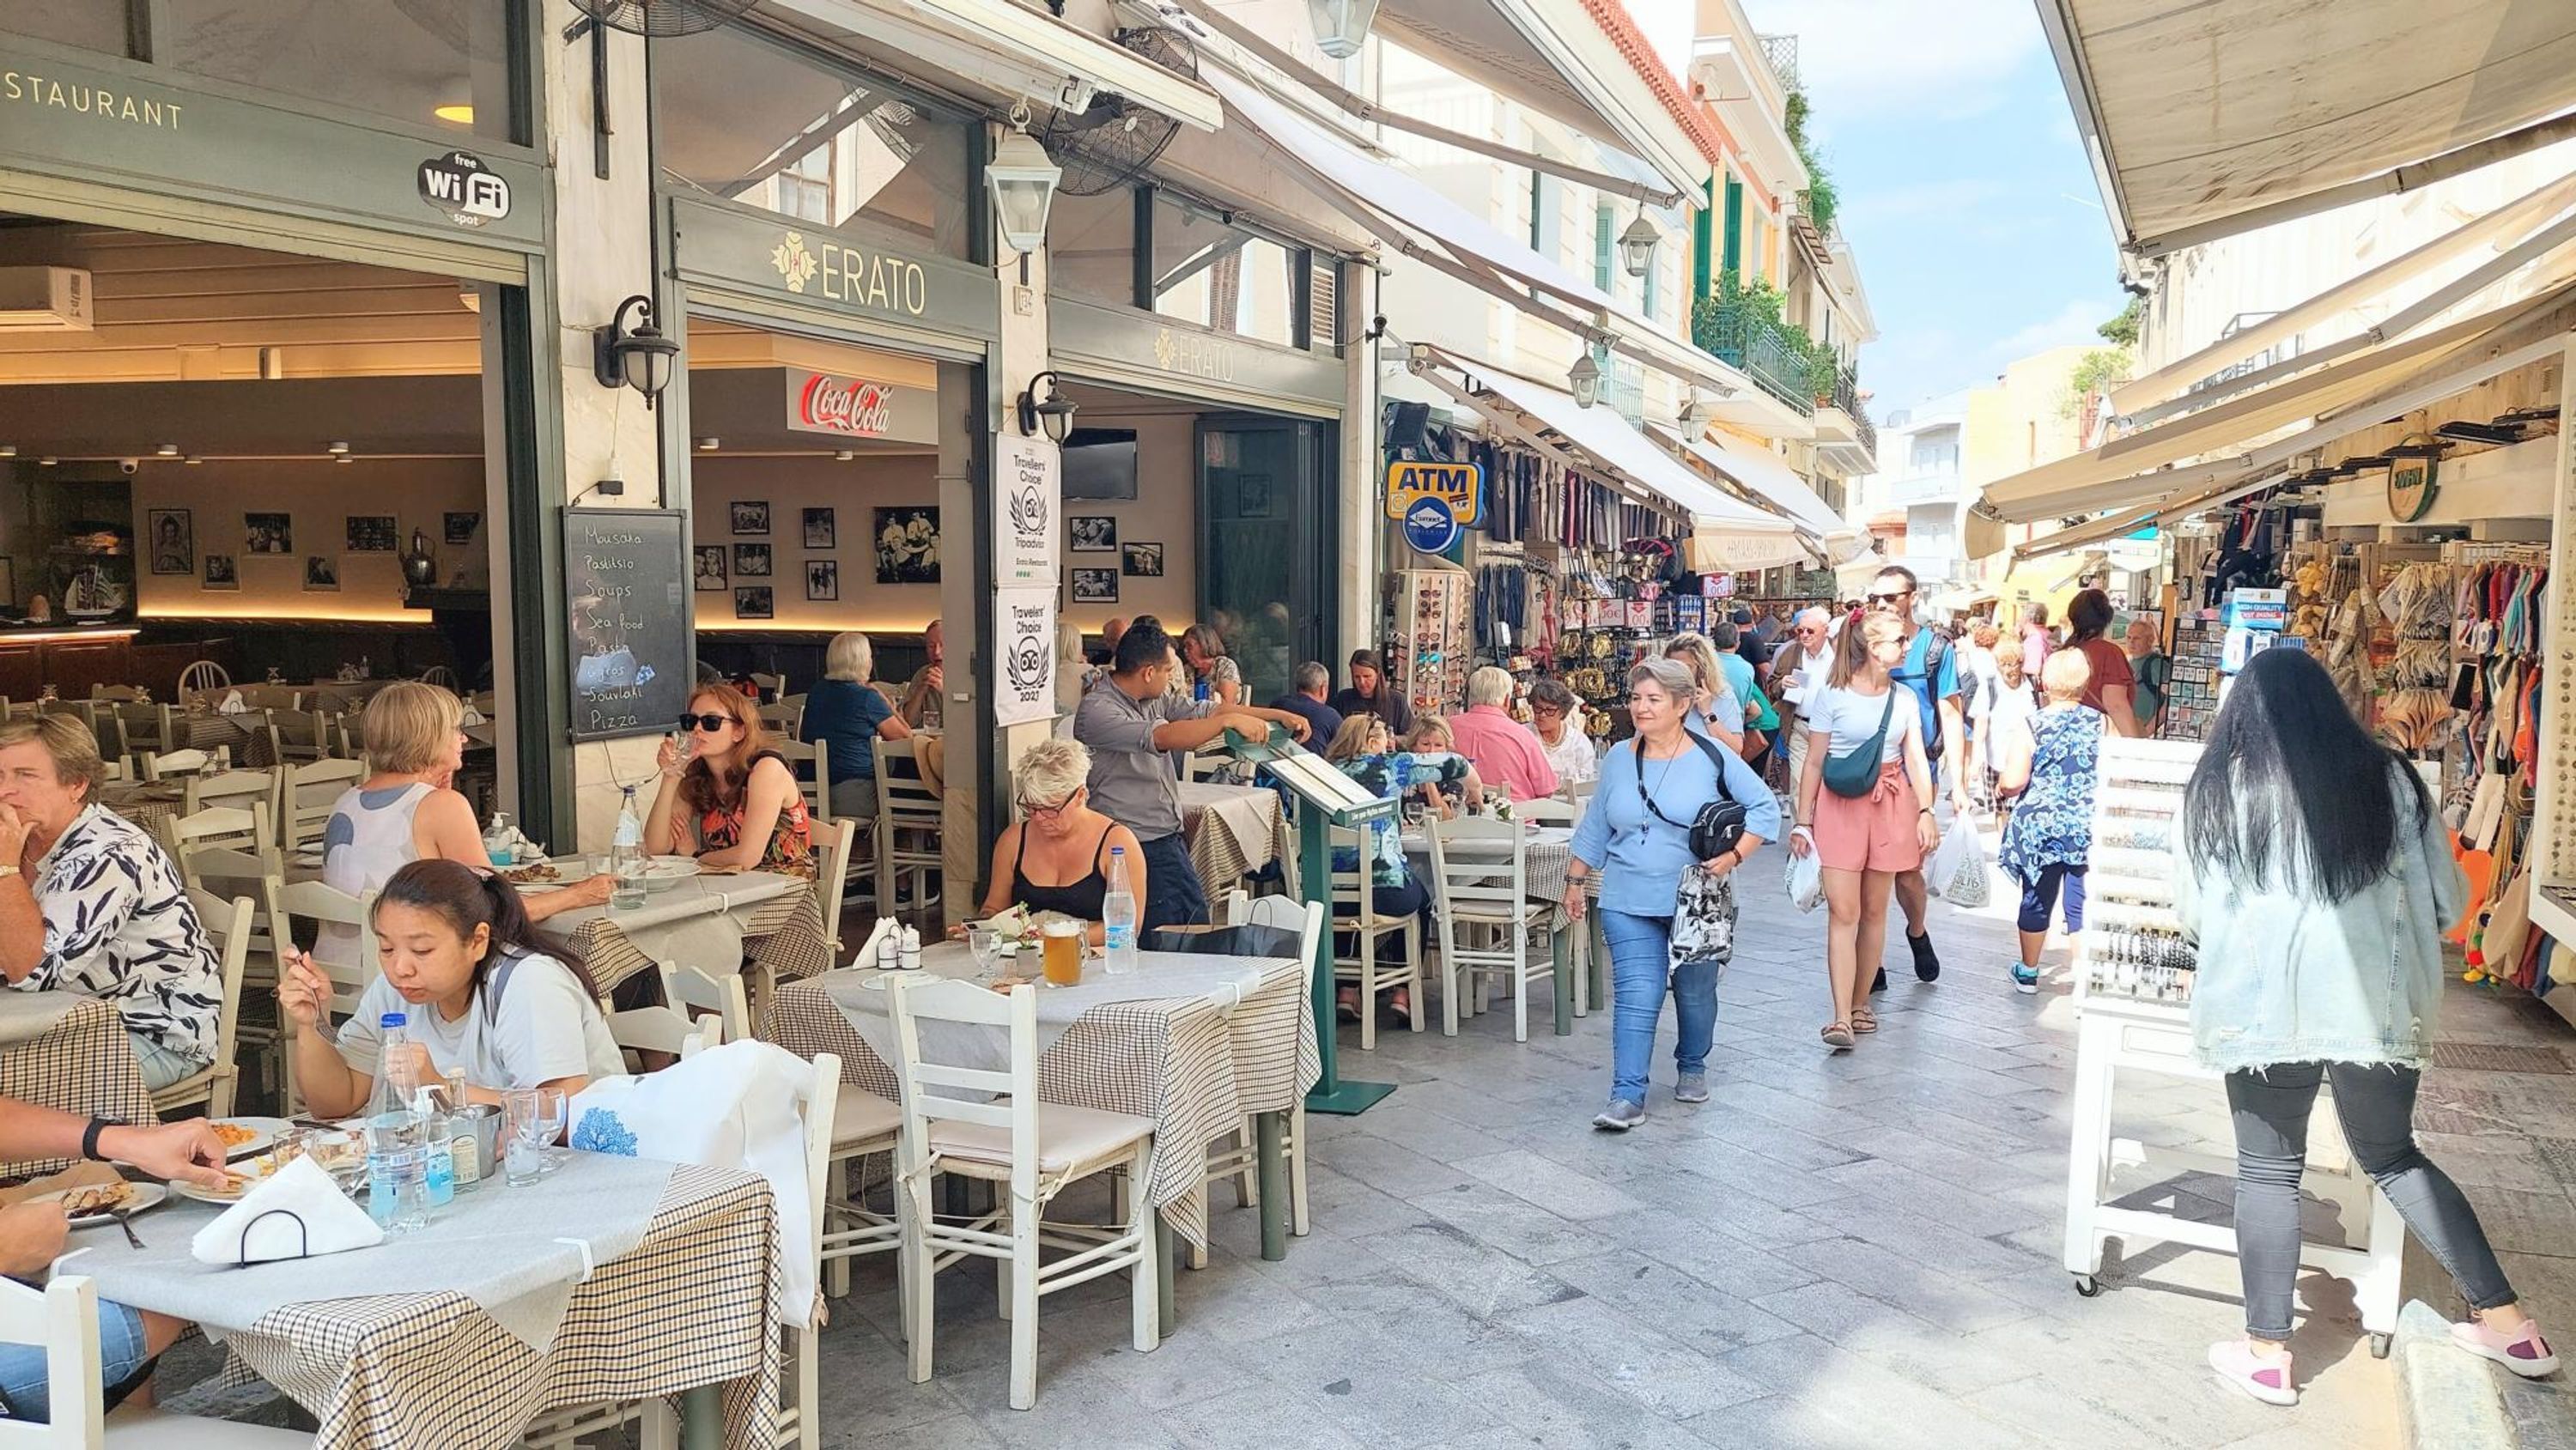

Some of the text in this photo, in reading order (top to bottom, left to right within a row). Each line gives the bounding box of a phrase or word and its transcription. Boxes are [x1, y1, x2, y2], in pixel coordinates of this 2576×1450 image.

[4, 71, 182, 130] STAURANT
[454, 153, 477, 168] free
[453, 213, 479, 227] spot
[822, 243, 925, 315] ERATO
[1179, 334, 1235, 382] ERATO
[1019, 470, 1042, 485] Choice
[1398, 467, 1467, 493] ATM
[586, 579, 632, 604] Soups
[586, 606, 611, 629] Sea
[1017, 620, 1042, 634] Choice
[588, 635, 629, 653] Pasta
[591, 709, 637, 730] Pizza
